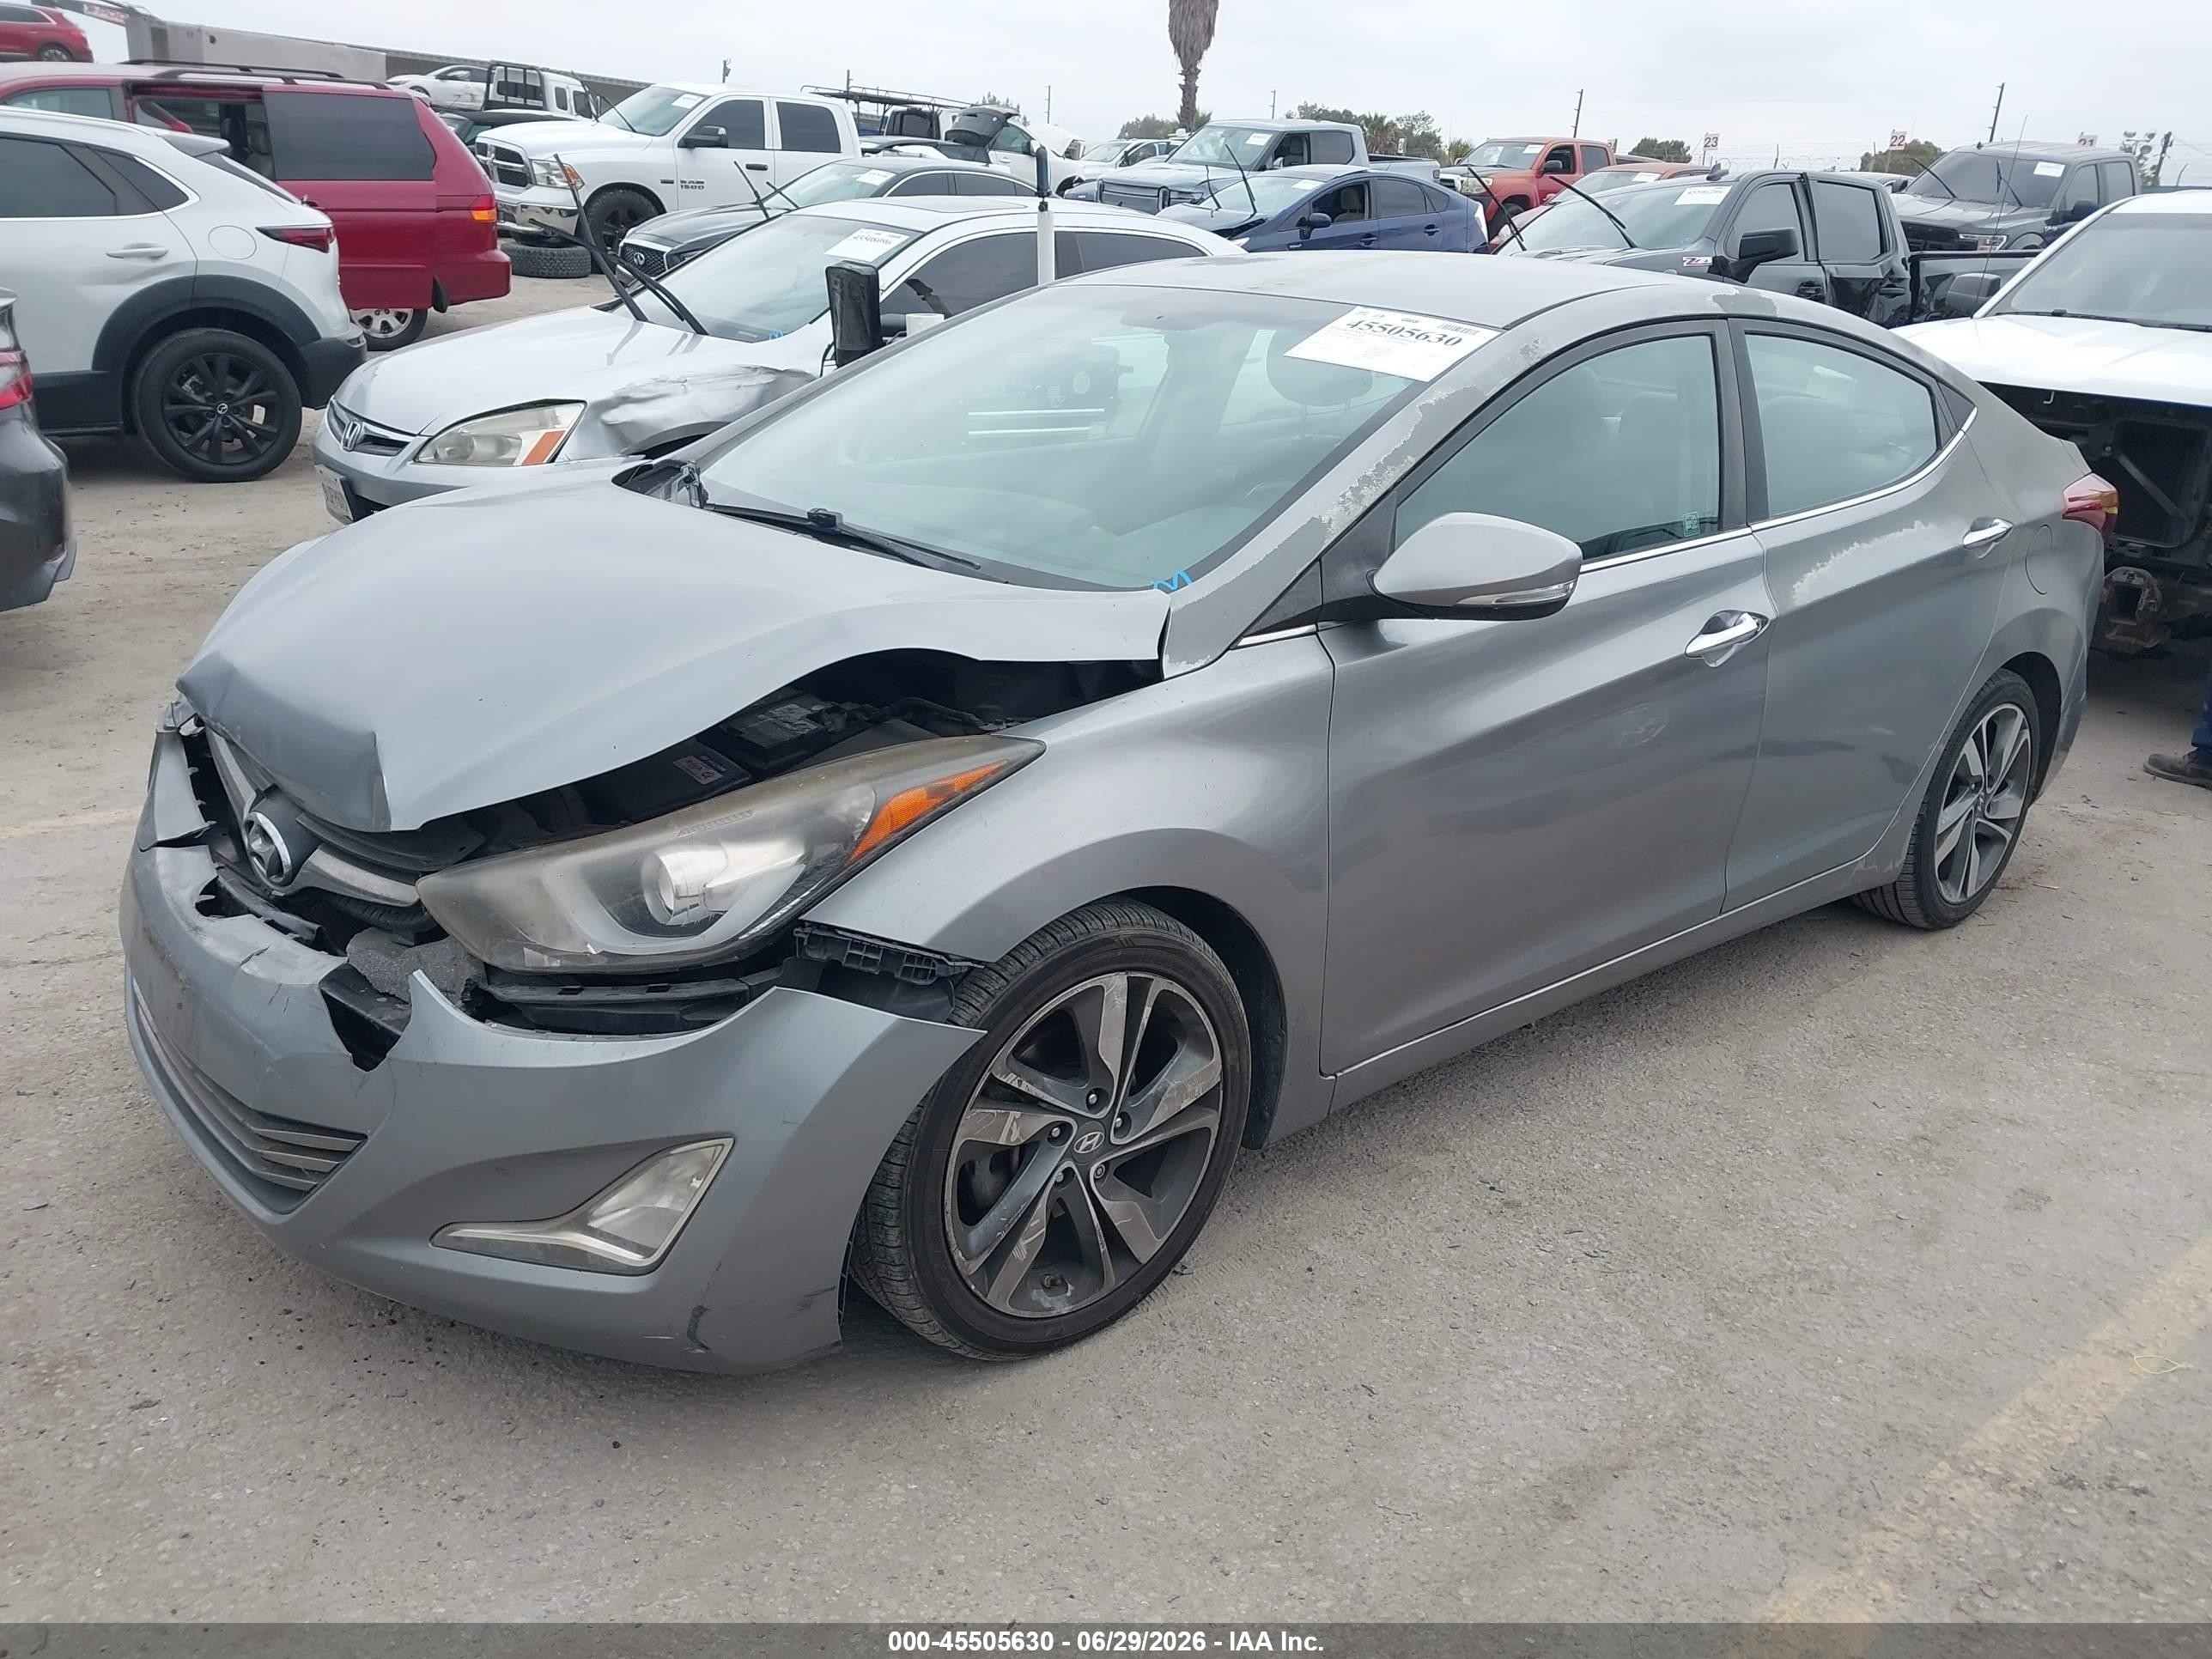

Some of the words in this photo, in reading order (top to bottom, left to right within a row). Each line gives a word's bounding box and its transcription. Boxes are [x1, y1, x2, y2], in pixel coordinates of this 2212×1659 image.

[1705, 137, 1717, 147] 23
[1890, 135, 1905, 146] 22
[1346, 319, 1462, 347] 45505630
